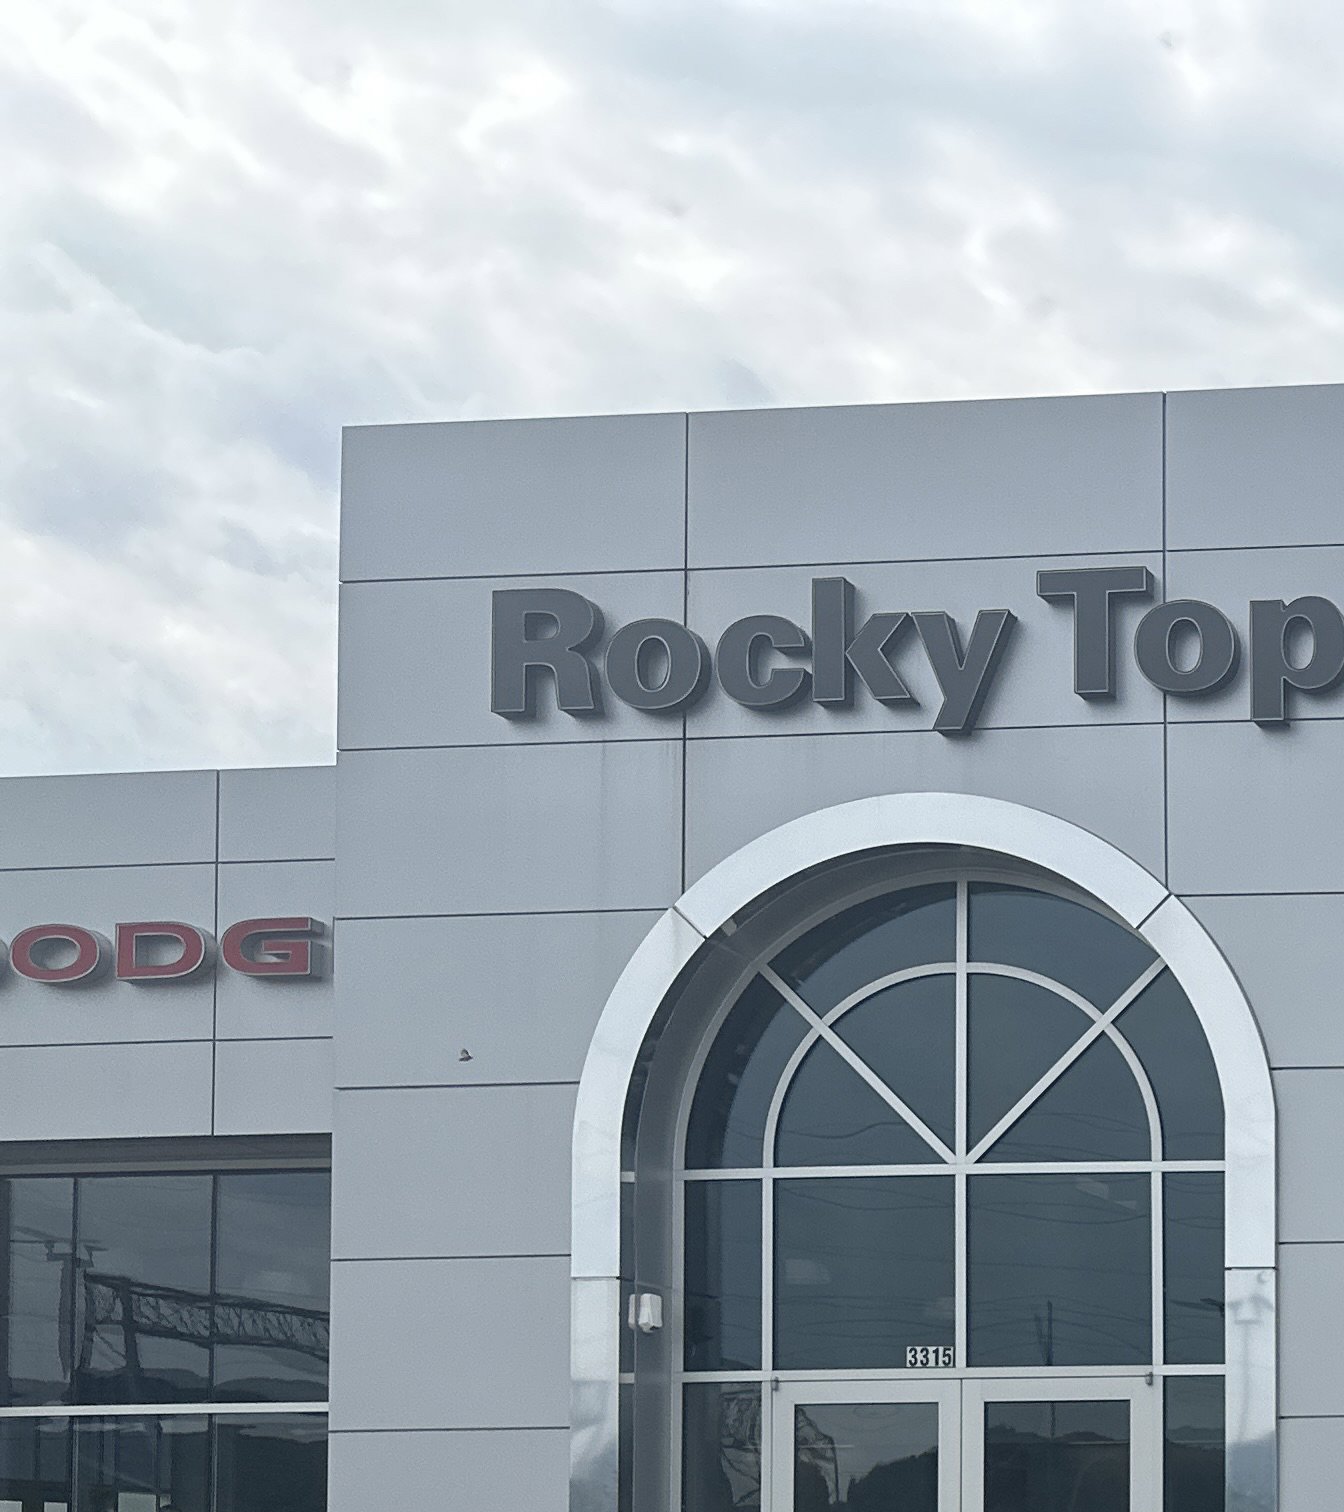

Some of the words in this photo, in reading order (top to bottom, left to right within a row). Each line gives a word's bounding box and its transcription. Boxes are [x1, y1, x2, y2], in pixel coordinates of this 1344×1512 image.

[490, 576, 1019, 737] Rocky
[0, 916, 326, 986] ODG
[908, 1347, 952, 1367] 3315
